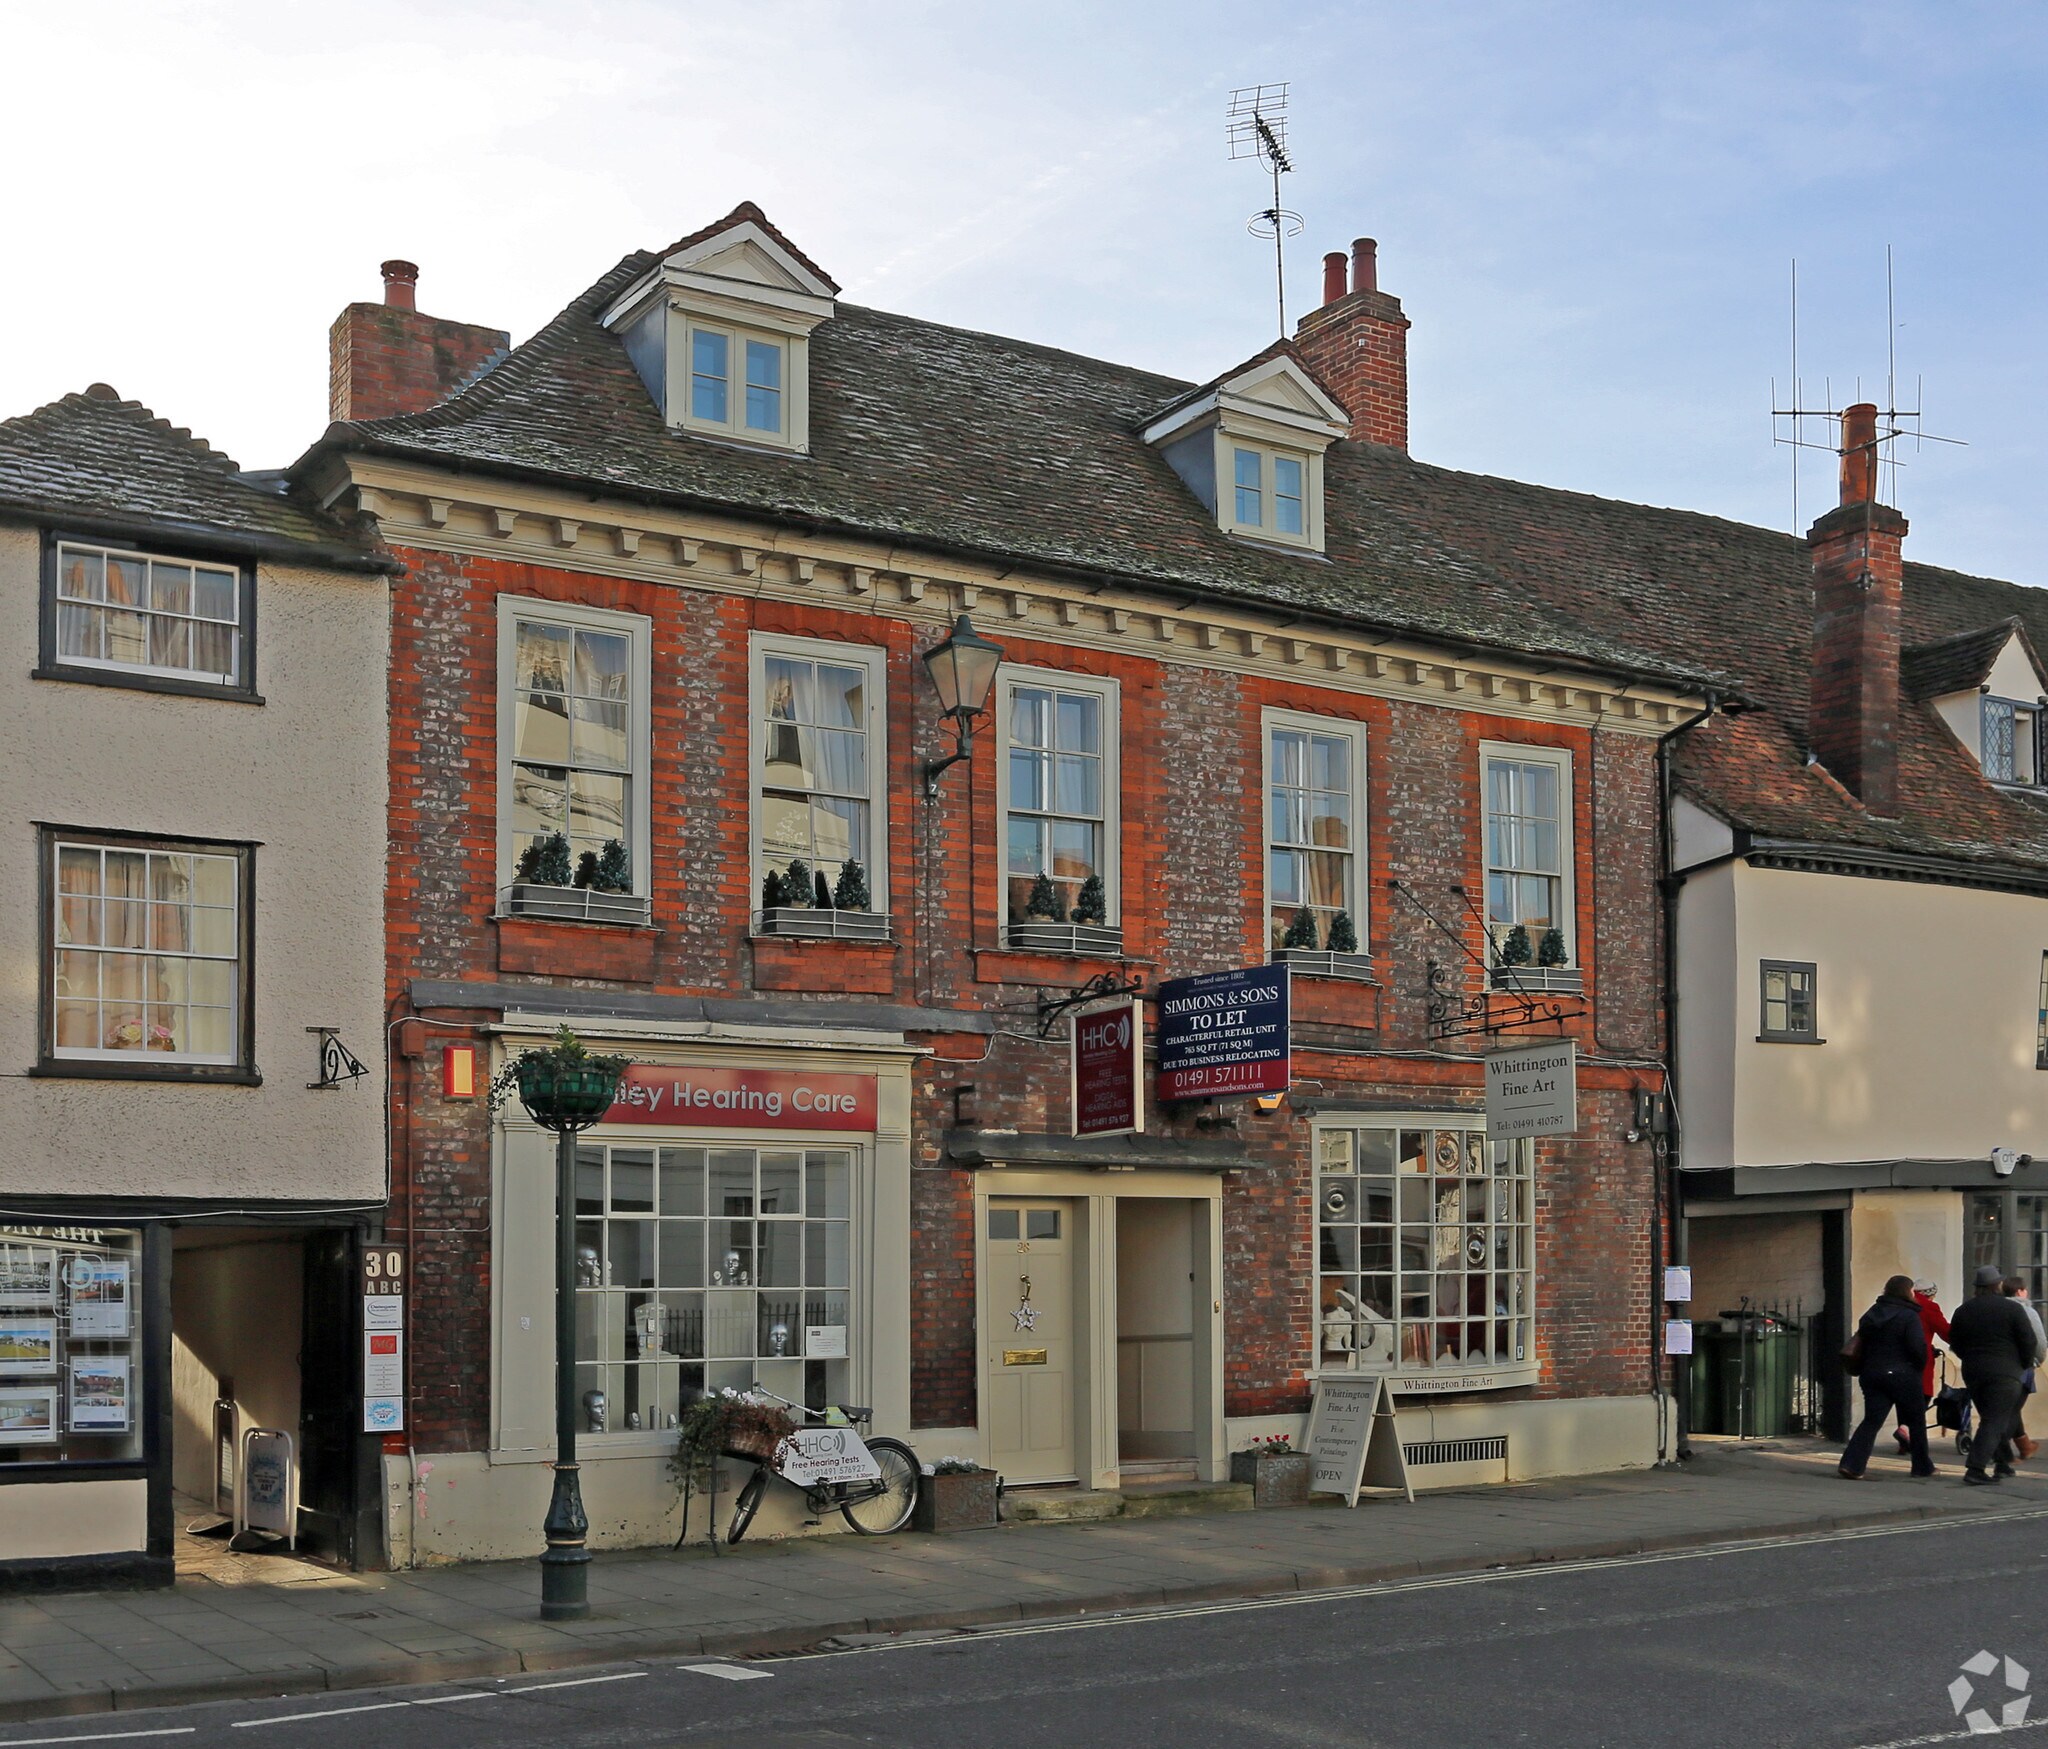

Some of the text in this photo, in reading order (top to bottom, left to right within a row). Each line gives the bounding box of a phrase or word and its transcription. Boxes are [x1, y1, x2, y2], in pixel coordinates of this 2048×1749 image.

[931, 783, 937, 792] 7
[1194, 971, 1245, 985] Trusted since 1802
[1165, 993, 1224, 1014] SIMMONS
[1227, 991, 1238, 1005] &
[1240, 986, 1279, 1003] SONS
[1190, 1010, 1247, 1030] TO LET
[1082, 1022, 1117, 1051] HHC
[1166, 1024, 1277, 1045] CHARACTERFUL RETAIL UNIT
[1196, 1045, 1207, 1054] SQ
[1207, 1043, 1218, 1051] FT
[1219, 1042, 1229, 1051] (71
[1229, 1040, 1242, 1050] SQ
[1242, 1039, 1253, 1048] M)
[1163, 1049, 1280, 1069] DUE TO BUSINESS RELOCATING
[1489, 1057, 1568, 1076] Whittington
[1175, 1064, 1261, 1087] 01491 571111
[1174, 1082, 1264, 1097] www.simmonsandsons.com
[1502, 1079, 1555, 1096] Fine Art
[673, 1081, 783, 1117] Hearing
[791, 1086, 857, 1114] Care
[1496, 1115, 1564, 1131] Tel: 01491 410787
[366, 1251, 401, 1277] 30
[366, 1280, 401, 1294] A B C
[1403, 1377, 1493, 1390] Whittington Fine Art
[1324, 1388, 1370, 1400] Whittington
[1327, 1402, 1360, 1413] Fine Art
[1330, 1424, 1344, 1433] Fie
[1315, 1435, 1358, 1446] Contemporary
[791, 1456, 860, 1469] Free Hearing Tests
[802, 1467, 836, 1478] Tel:01491
[839, 1464, 866, 1474] 576927
[1316, 1469, 1342, 1481] OPEN
